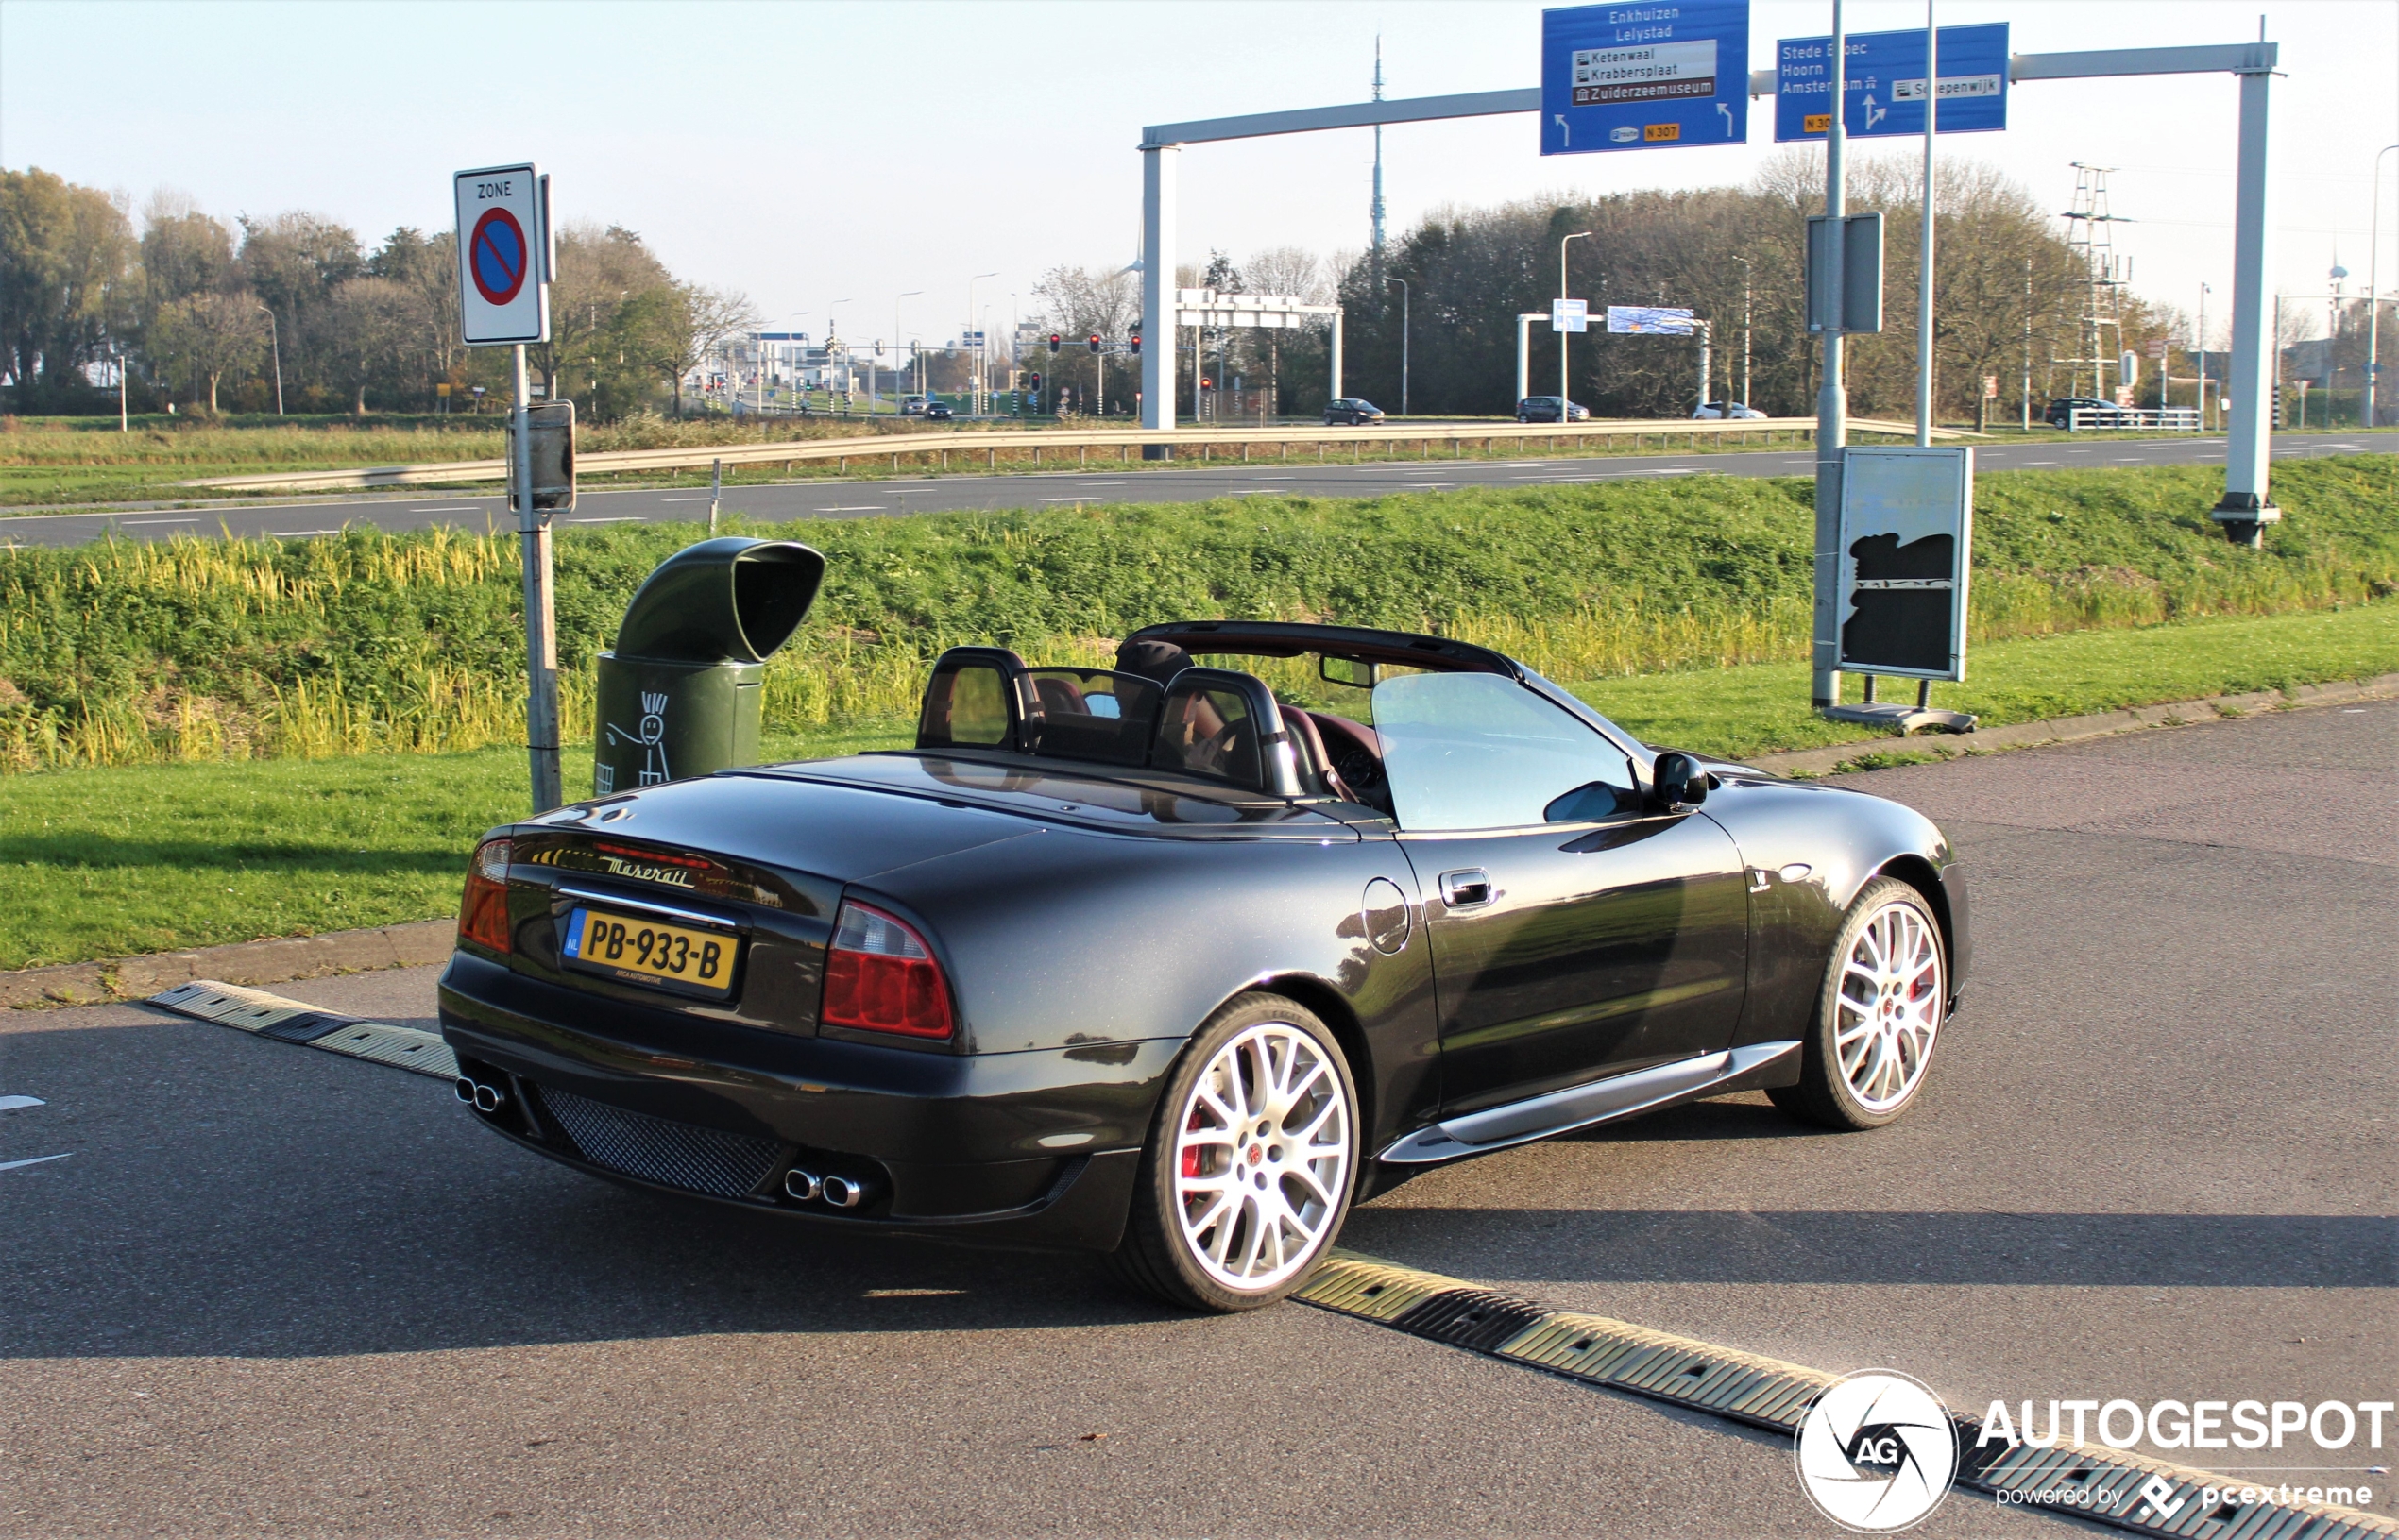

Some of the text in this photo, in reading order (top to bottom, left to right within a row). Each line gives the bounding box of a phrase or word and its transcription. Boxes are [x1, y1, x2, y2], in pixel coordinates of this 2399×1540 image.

[1609, 8, 1679, 25] Enkhuizen
[1615, 25, 1673, 42] Lelystad
[1591, 48, 1655, 64] Ketenwaal
[1782, 43, 1867, 59] Stede Boec
[1591, 63, 1678, 81] Krabbersplaat
[1781, 64, 1824, 76] Hoorn
[1591, 81, 1712, 100] Zuiderzeemuseum
[1781, 79, 1862, 94] Amsteram
[1914, 78, 1996, 95] Scepenwijk
[1807, 118, 1830, 128] N 30
[1646, 126, 1677, 138] N 307
[477, 180, 512, 200] ZONE
[602, 855, 696, 888] Maserati
[567, 938, 579, 951] NL
[587, 919, 722, 980] PB-933-B
